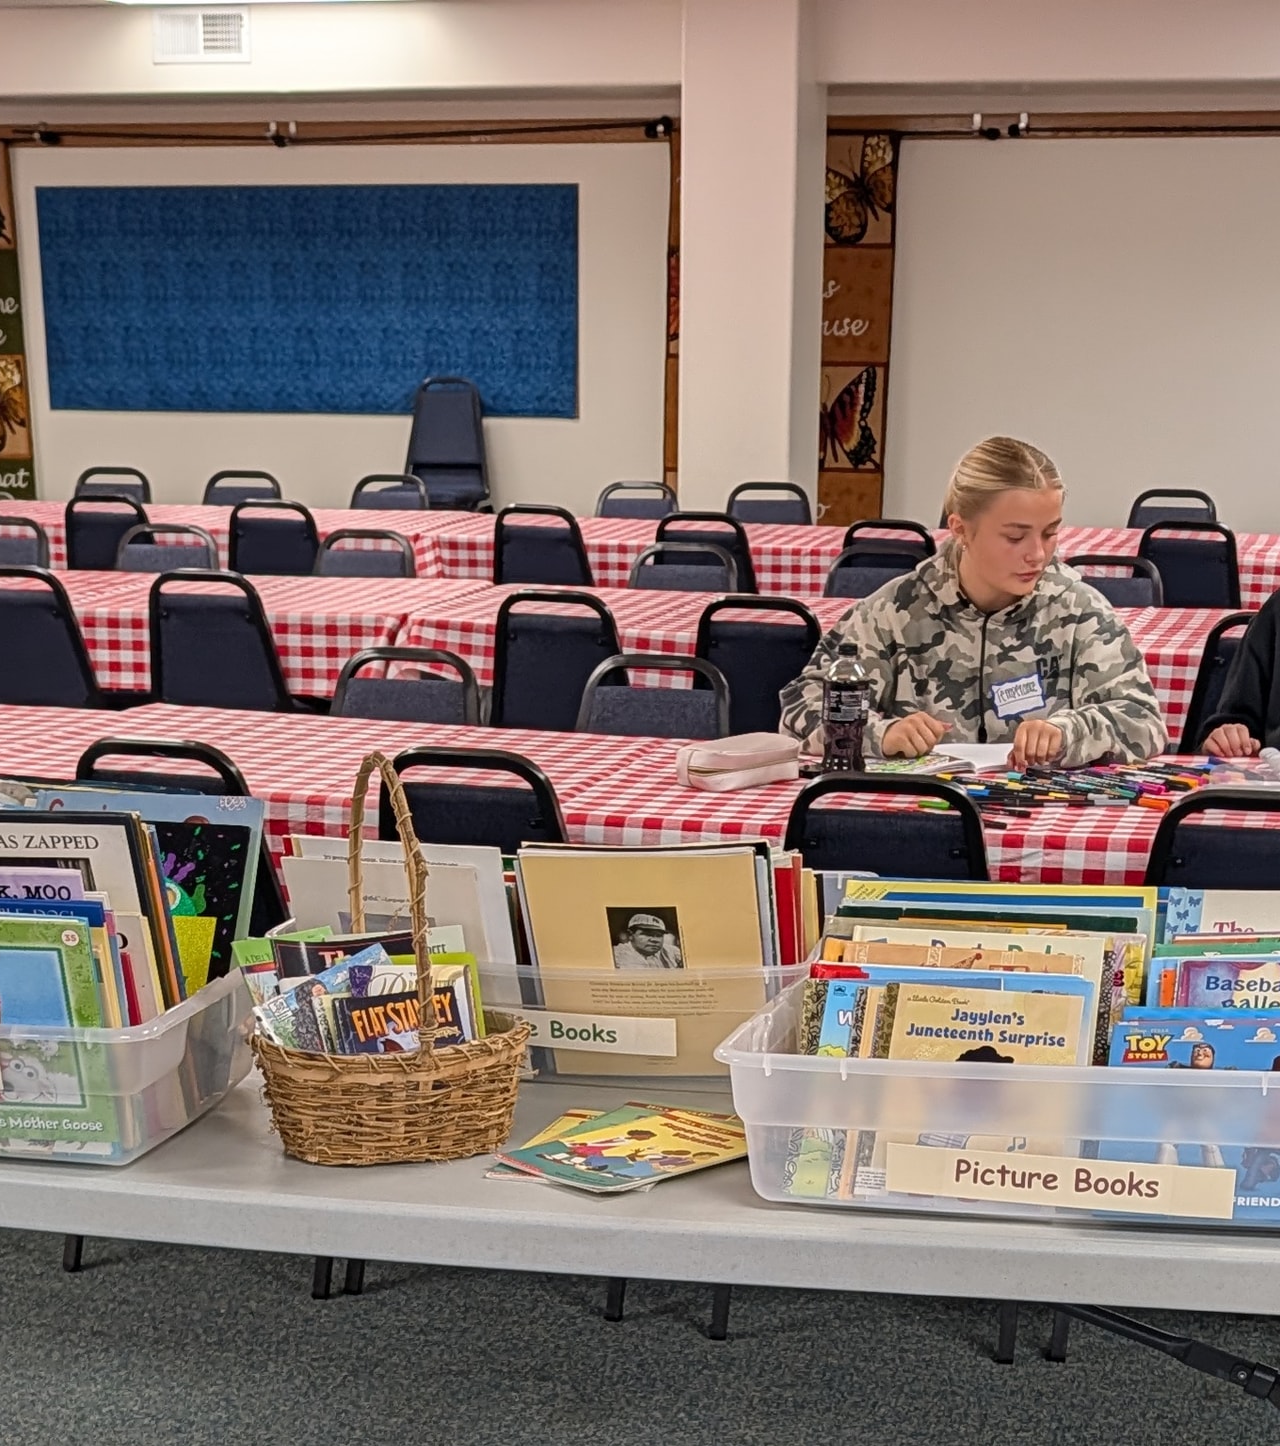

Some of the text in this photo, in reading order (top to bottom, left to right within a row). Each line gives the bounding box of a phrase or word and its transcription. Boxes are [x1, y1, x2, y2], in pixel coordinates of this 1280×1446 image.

[22, 835, 99, 850] ZAPPED
[22, 885, 71, 901] MOO
[1213, 921, 1254, 933] The
[351, 1005, 389, 1043] FLAT
[951, 1008, 1025, 1026] Jayylen's
[550, 1020, 617, 1043] Books
[906, 1023, 1065, 1048] Juneteenth Surprise
[1123, 1034, 1173, 1051] TOY
[1127, 1052, 1167, 1061] STORY
[10, 1115, 59, 1131] Mother
[62, 1118, 104, 1132] Goose
[954, 1159, 1160, 1199] Picture Books
